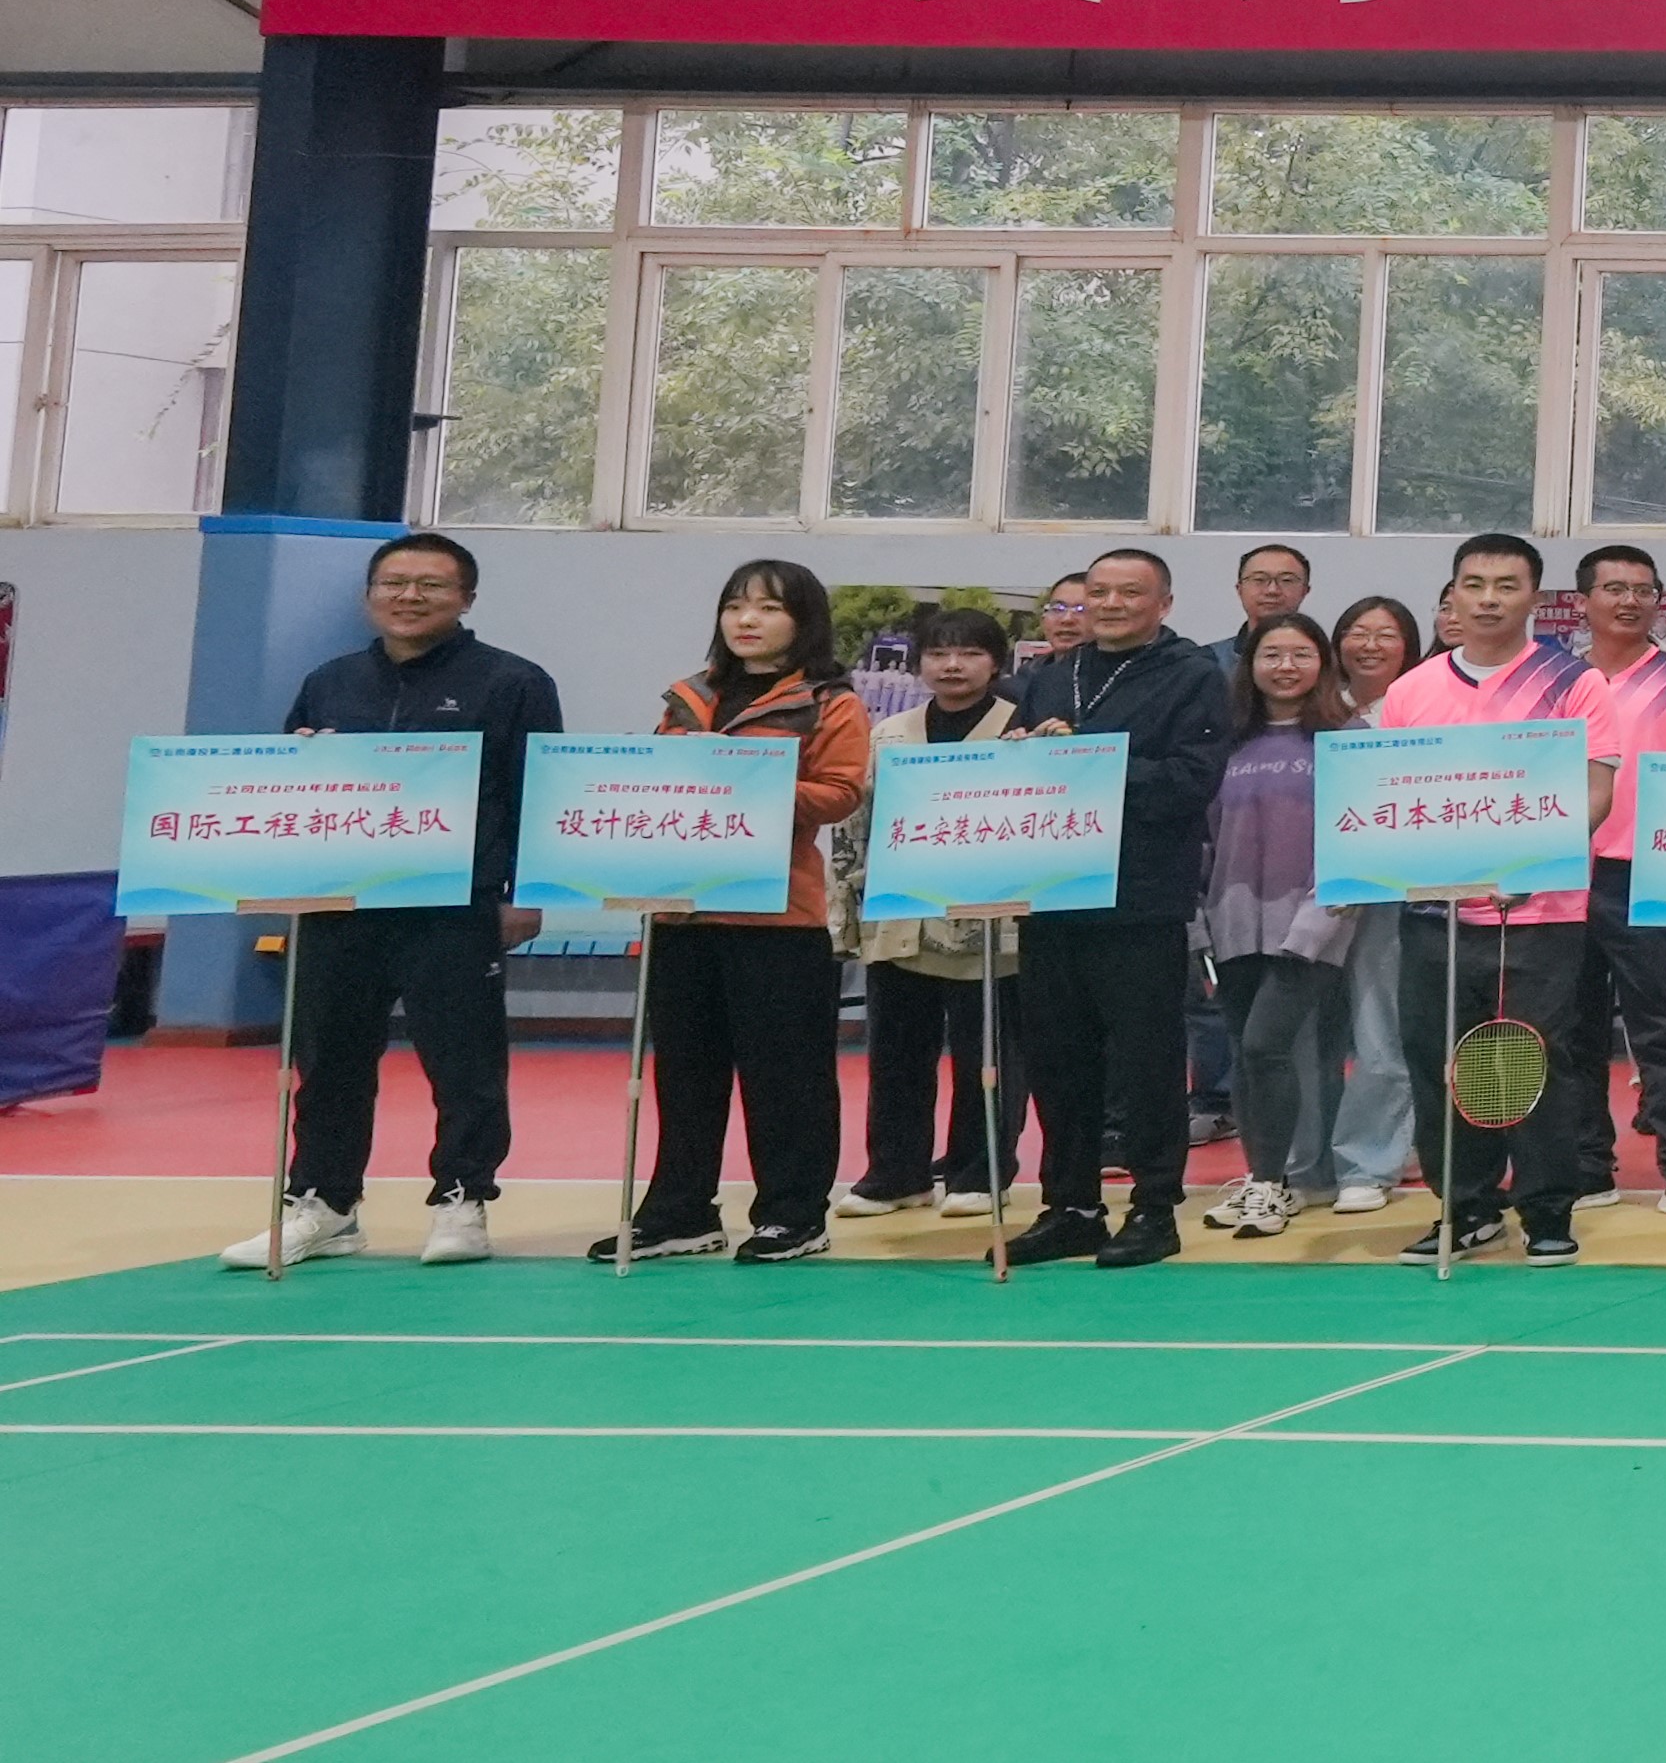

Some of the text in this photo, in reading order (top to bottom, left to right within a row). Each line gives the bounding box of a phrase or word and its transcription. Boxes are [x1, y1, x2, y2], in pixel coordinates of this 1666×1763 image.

[151, 807, 452, 841] 国际工程部代表队
[556, 808, 755, 841] 设计院代表队
[887, 809, 1104, 851] 第二安装分公司代表队
[1335, 794, 1569, 833] 公司本部代表队
